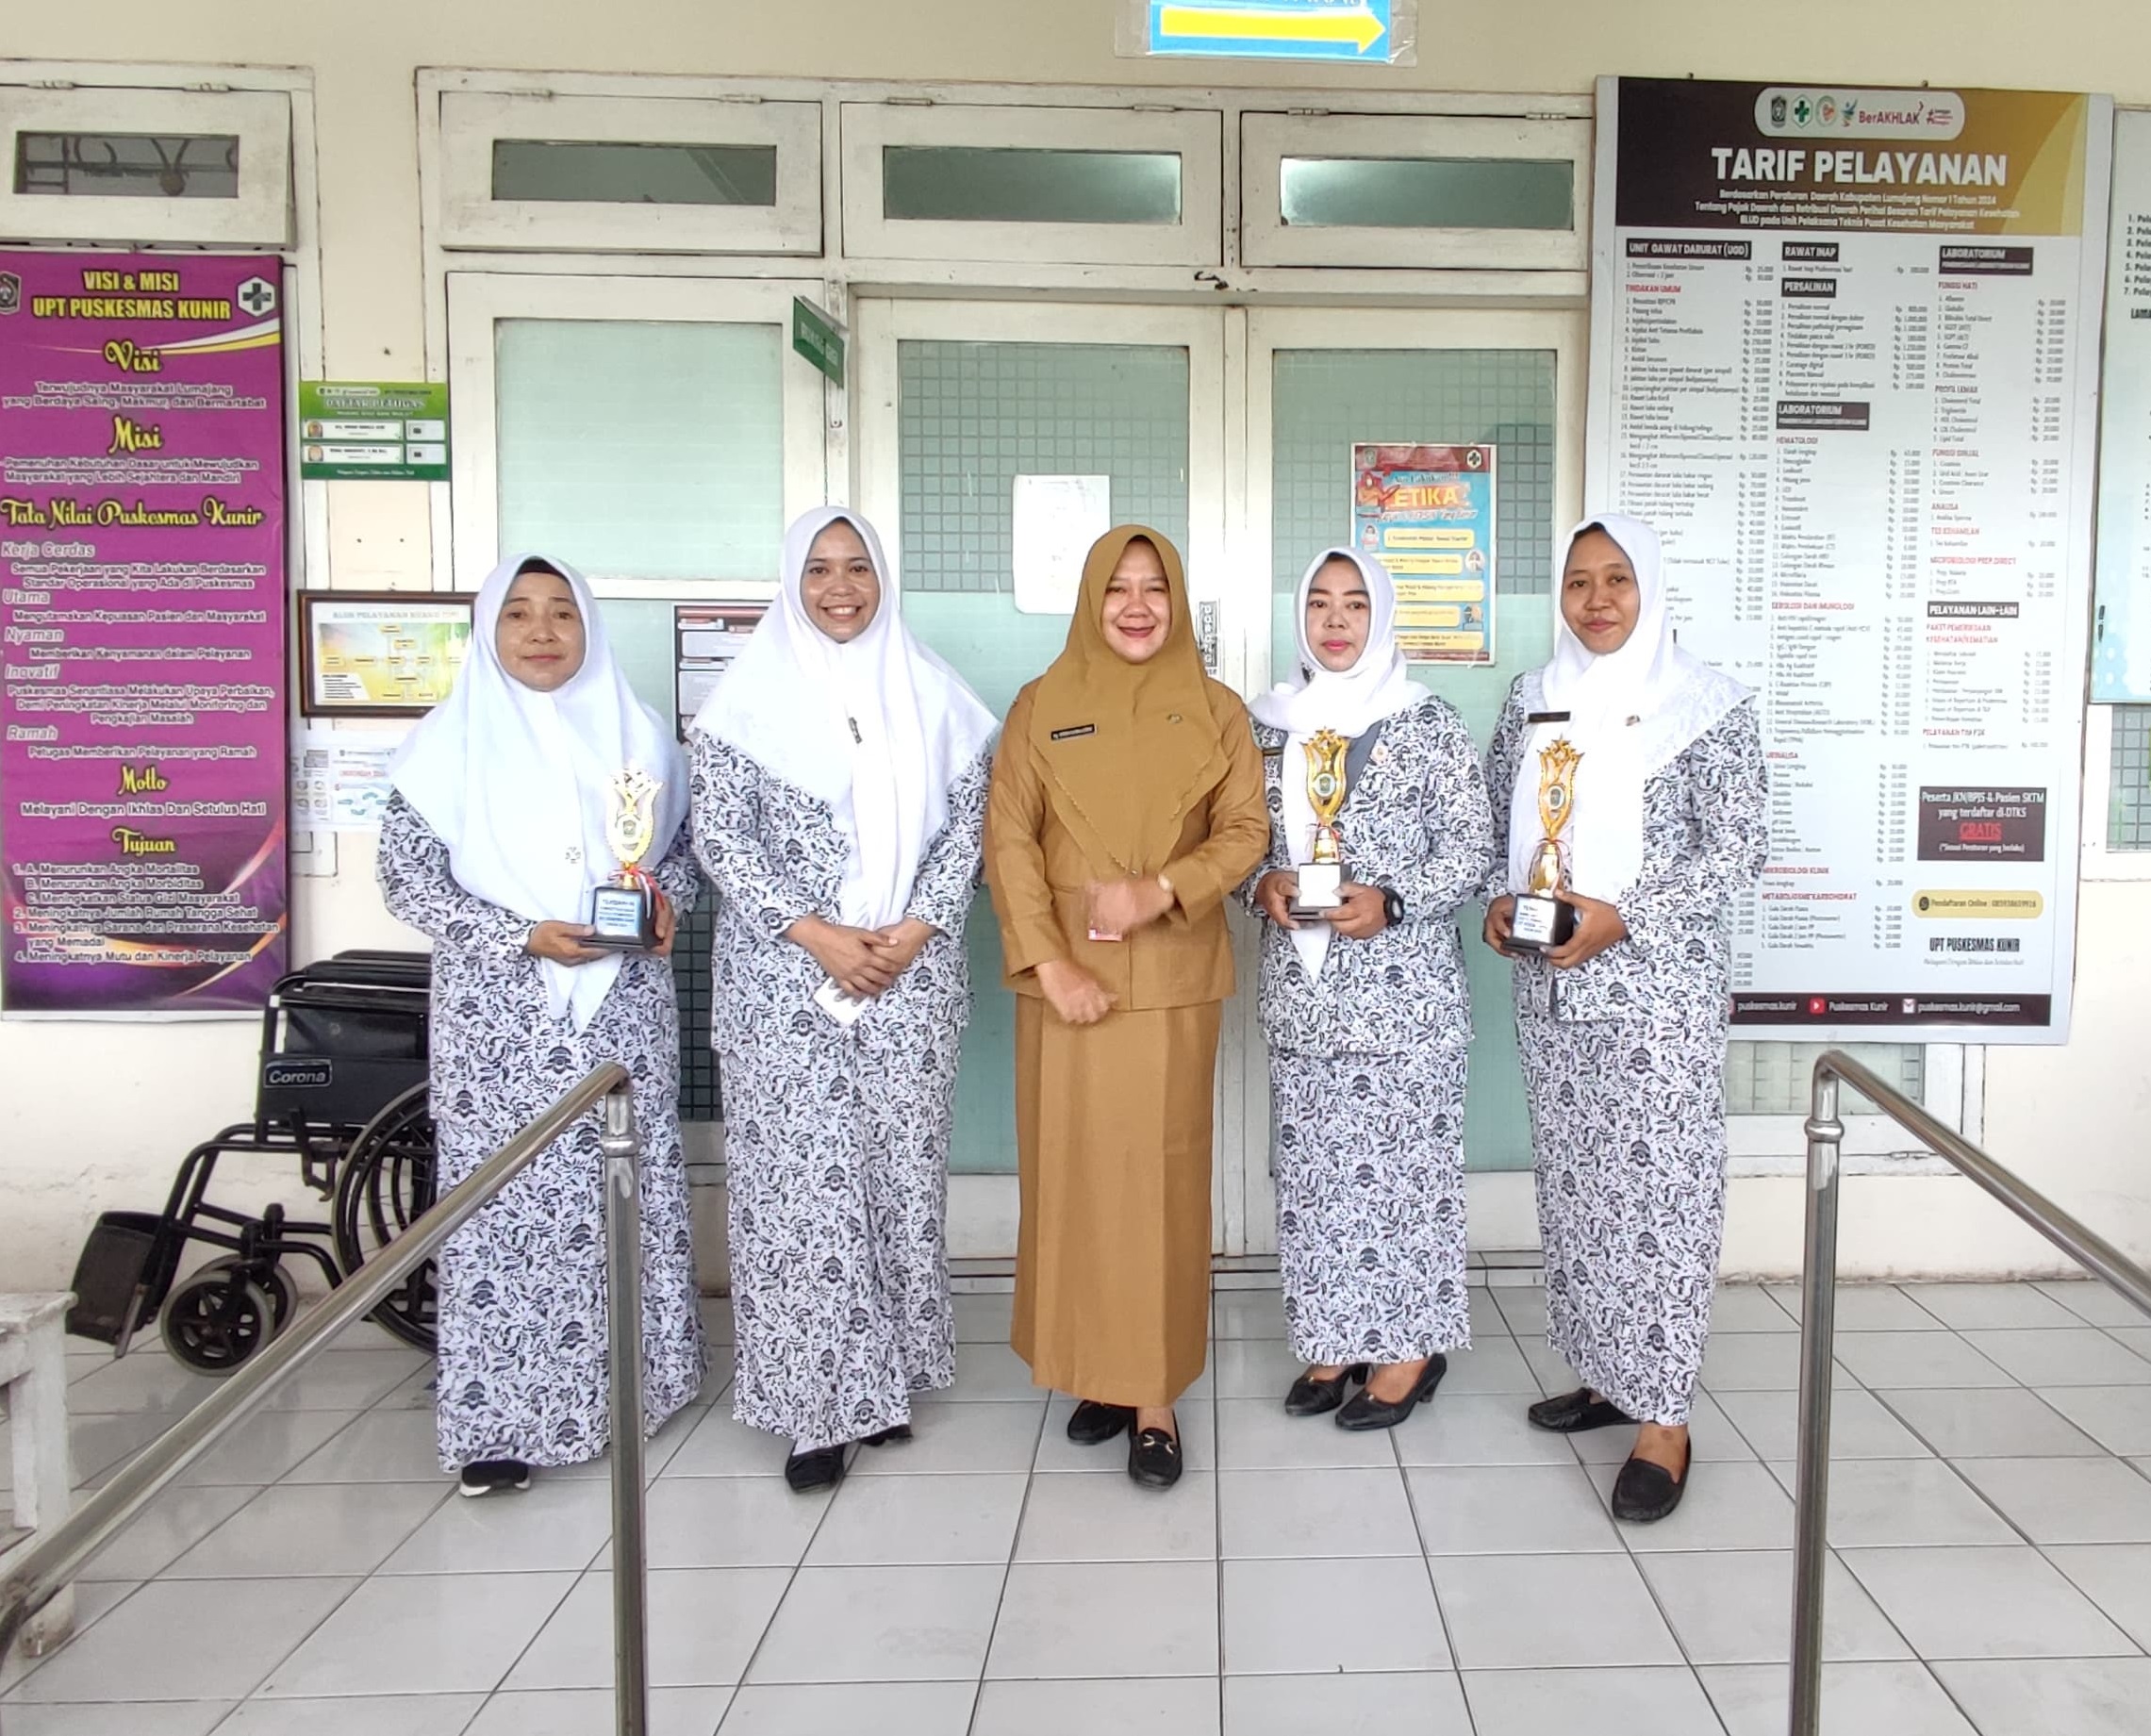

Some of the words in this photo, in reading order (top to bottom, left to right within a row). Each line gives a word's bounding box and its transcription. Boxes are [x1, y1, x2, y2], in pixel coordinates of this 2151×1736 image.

[1859, 110, 1920, 124] BerAKHLAK
[1712, 148, 1806, 181] TARIF
[1814, 151, 2007, 187] PELAYANAN
[1630, 242, 1647, 254] UNIT
[1651, 243, 1682, 255] GAWAT
[1683, 244, 1722, 256] DARURAT
[1724, 242, 1748, 256] (UGD)
[1785, 246, 1815, 256] RAWAT
[1816, 247, 1836, 257] INAP
[1943, 248, 2006, 258] LABORATORIUM
[83, 271, 119, 290] VISI
[124, 274, 136, 290] &
[139, 272, 179, 291] MISI
[1784, 281, 1833, 292] PERSALINAN
[32, 297, 66, 317] UPT
[70, 298, 174, 319] PUSKESMAS
[177, 300, 231, 320] KUNIR
[104, 340, 161, 372] Visi
[36, 381, 108, 395] Terwujudnya
[110, 382, 174, 396] Masyarakat
[177, 383, 232, 397] Lumajang
[1779, 405, 1842, 415] LABORATORIUM
[108, 417, 163, 454] Misi
[5, 457, 67, 470] Pemenuhan
[69, 457, 126, 470] Kebutuhan
[128, 458, 159, 470] Dasar
[161, 458, 191, 470] untuk
[192, 458, 259, 472] Mewujudkan
[5, 471, 67, 484] Masyarakat
[68, 472, 93, 485] yang
[95, 471, 125, 483] Lebih
[127, 472, 177, 486] Sejahtera
[179, 472, 200, 484] dan
[201, 472, 240, 484] Mandiri
[1395, 487, 1460, 506] ETIKA
[0, 499, 46, 525] Tata
[49, 501, 92, 528] Nilai
[97, 501, 199, 525] Puskesmas
[203, 497, 264, 525] Kunir
[2, 541, 39, 559] Kerja
[42, 542, 95, 557] Cerdas
[10, 563, 48, 575] Semua
[50, 563, 103, 577] Pekerjaan
[104, 565, 130, 578] yang
[132, 563, 153, 575] Kita
[155, 563, 198, 575] Lakukan
[200, 564, 267, 576] Berdasarkan
[24, 576, 65, 588] Standar
[66, 576, 129, 590] Operasional
[131, 578, 158, 591] yang
[159, 577, 181, 589] Ada
[182, 577, 193, 589] di
[194, 577, 255, 589] Puskesmas
[3, 588, 50, 603] Utama
[13, 610, 92, 623] Mengutamakan
[94, 610, 146, 623] Kepuasan
[148, 610, 184, 622] Pasien
[185, 611, 205, 622] dan
[206, 611, 266, 624] Masyarakat
[1929, 605, 1977, 616] PELAYANAN
[1977, 605, 2017, 616] LAIN-LAIN
[5, 627, 64, 645] Nyaman
[30, 648, 94, 659] Memberikan
[95, 648, 162, 661] Kenyamanan
[163, 648, 196, 659] dalam
[197, 648, 252, 662] Pelayanan
[5, 664, 60, 679] Inovatif
[8, 685, 68, 697] Puskesmas
[69, 685, 126, 697] Senantiasa
[127, 685, 184, 697] Melakukan
[186, 685, 219, 699] Upaya
[17, 699, 45, 711] Demi
[46, 699, 110, 713] Peningkatan
[112, 699, 149, 713] Kinerja
[150, 699, 188, 711] Melalui
[190, 699, 245, 713] Monitoring
[247, 699, 267, 711] dan
[91, 712, 149, 726] Pengkajian
[150, 712, 193, 724] Masalah
[7, 725, 58, 740] Ramah
[28, 746, 72, 760] Petugas
[73, 746, 137, 758] Memberikan
[138, 746, 191, 760] Pelayanan
[192, 748, 219, 760] yang
[220, 746, 256, 758] Ramah
[117, 766, 168, 795] Motto
[21, 802, 76, 818] Melayani
[77, 802, 125, 819] Dengan
[127, 802, 164, 816] Ikhlas
[167, 802, 190, 816] Dan
[192, 802, 239, 817] Setulus
[240, 802, 266, 816] Hati
[1960, 822, 2002, 838] GRATIS
[112, 826, 175, 856] Tujuan
[40, 863, 108, 875] Menurunkan
[110, 863, 143, 877] Angka
[145, 863, 199, 875] Mortalitas
[40, 877, 108, 889] Menurunkan
[110, 877, 143, 892] Angka
[145, 877, 204, 889] Morbiditas
[40, 892, 117, 906] Meningkatkan
[118, 892, 153, 904] Status
[155, 892, 176, 904] Gizi
[177, 892, 240, 906] Masyarakat
[27, 906, 103, 920] Meningkatnya
[104, 906, 144, 918] Jumlah
[145, 906, 184, 918] Rumah
[186, 906, 225, 921] Tangga
[226, 906, 258, 919] Sehat
[27, 921, 103, 935] Meningkatnya
[104, 920, 142, 934] Sarana
[144, 920, 166, 934] dan
[167, 921, 222, 934] Prasarana
[223, 921, 280, 934] Kesehatan
[27, 937, 55, 951] yang
[57, 936, 105, 947] Memadai
[1929, 937, 1944, 951] UPT
[1946, 937, 1994, 952] PUSKESMAS
[1996, 938, 2020, 952] KUNIR
[27, 950, 103, 965] Meningkatnya
[105, 950, 134, 962] Mutu
[135, 951, 156, 962] dan
[157, 950, 195, 965] Kinerja
[196, 950, 253, 965] Pelayanan
[270, 1070, 326, 1083] Corona
